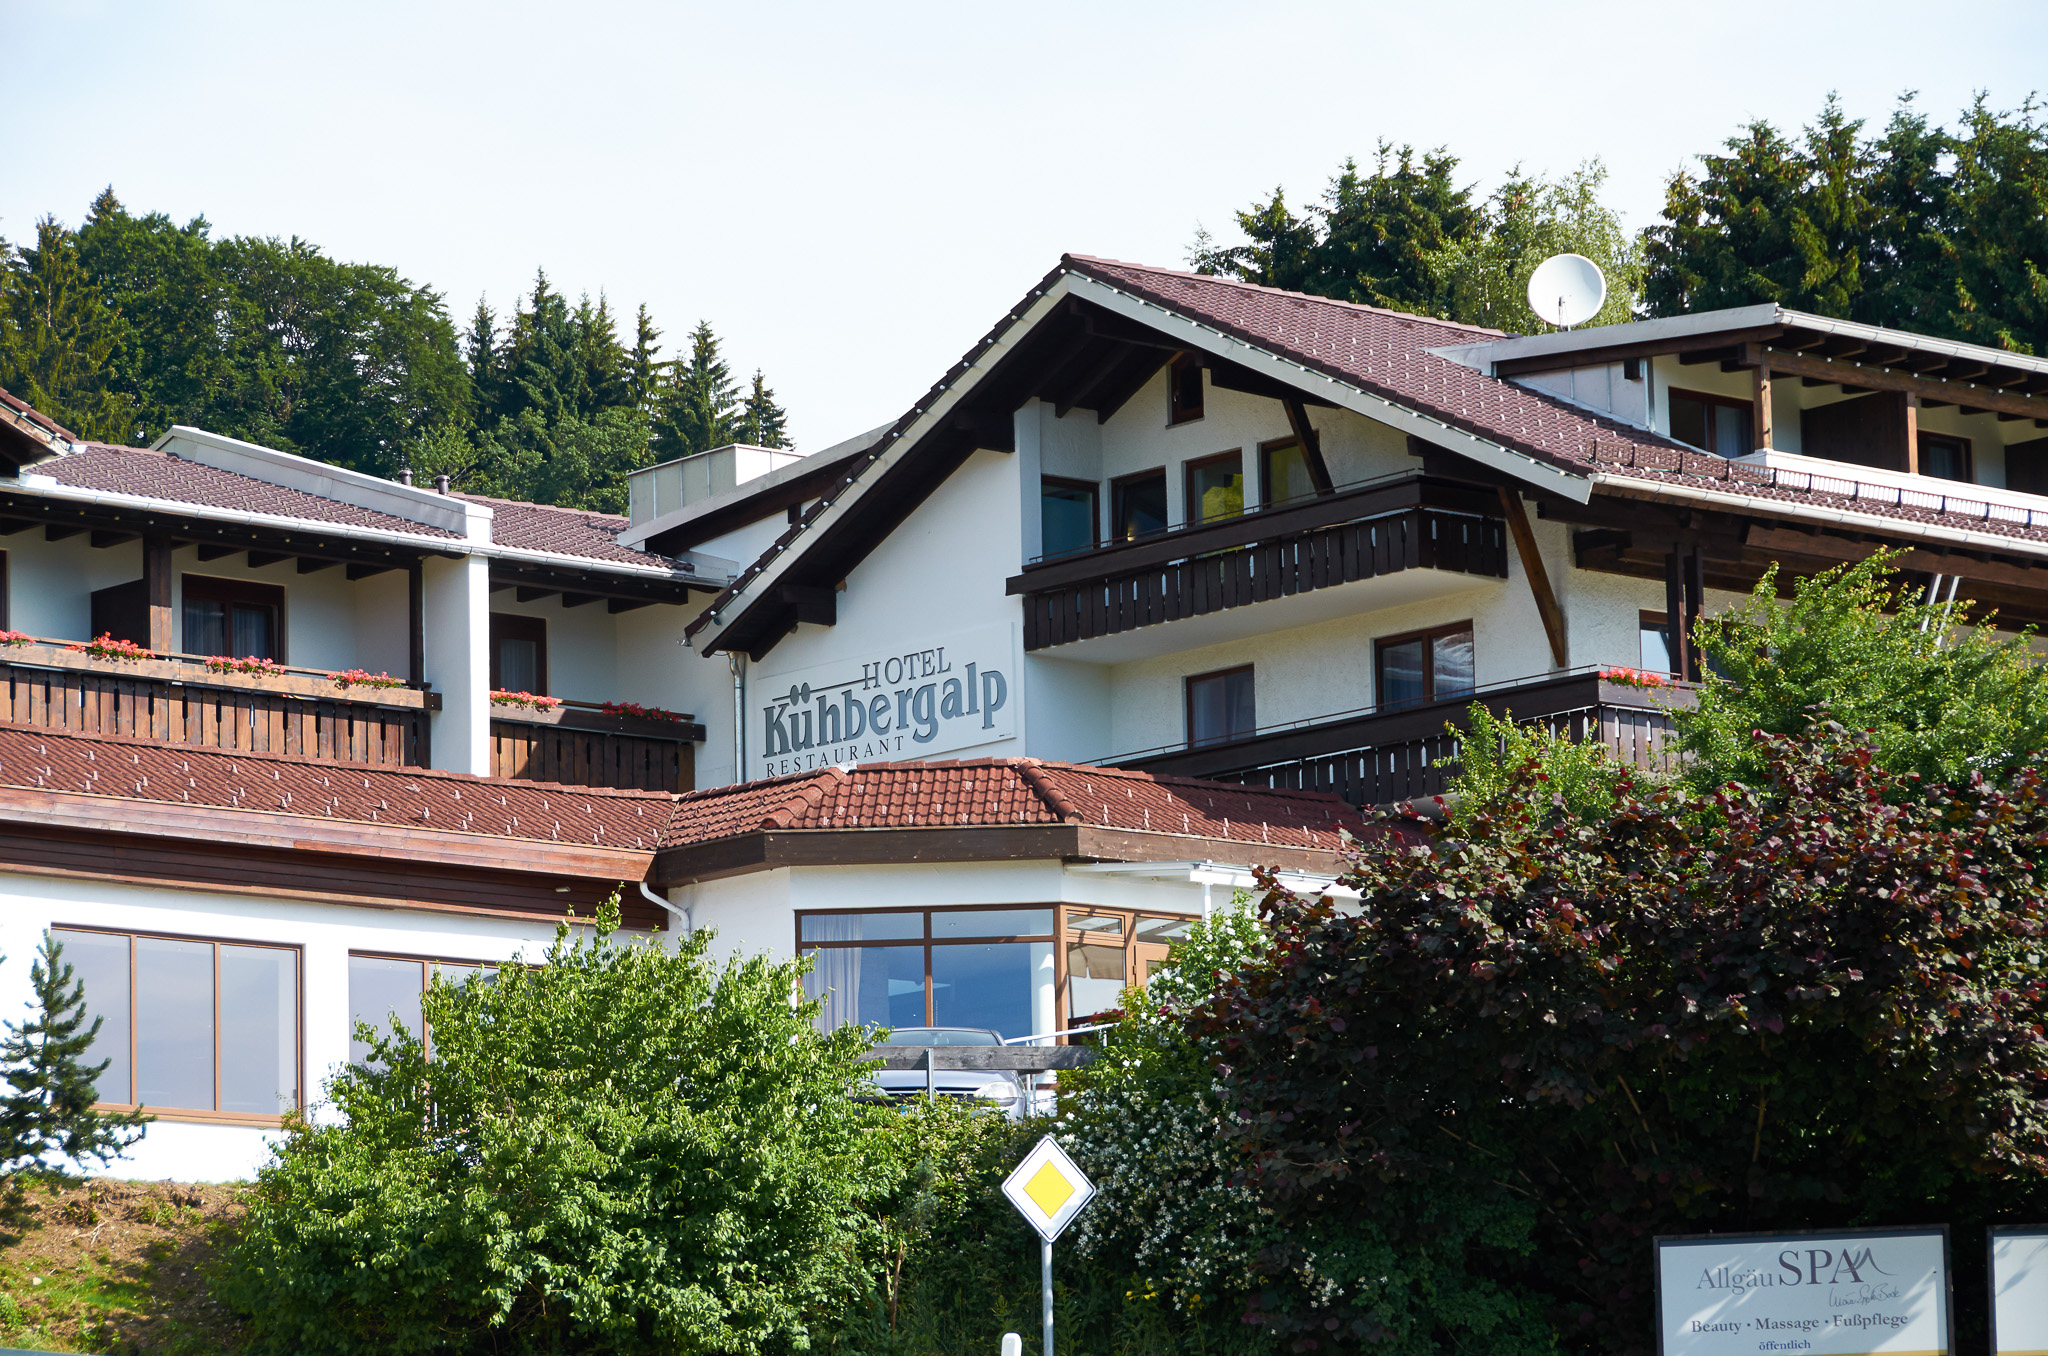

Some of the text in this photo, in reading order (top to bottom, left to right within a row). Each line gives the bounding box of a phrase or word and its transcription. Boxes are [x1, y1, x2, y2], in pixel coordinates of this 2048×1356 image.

[862, 647, 951, 690] HOTEL
[762, 662, 1007, 758] Kühbergalp
[766, 736, 904, 778] RESTAURANT
[1691, 1313, 1909, 1335] Beauty Massage Fußpflege
[1758, 1340, 1811, 1351] öffentlich
